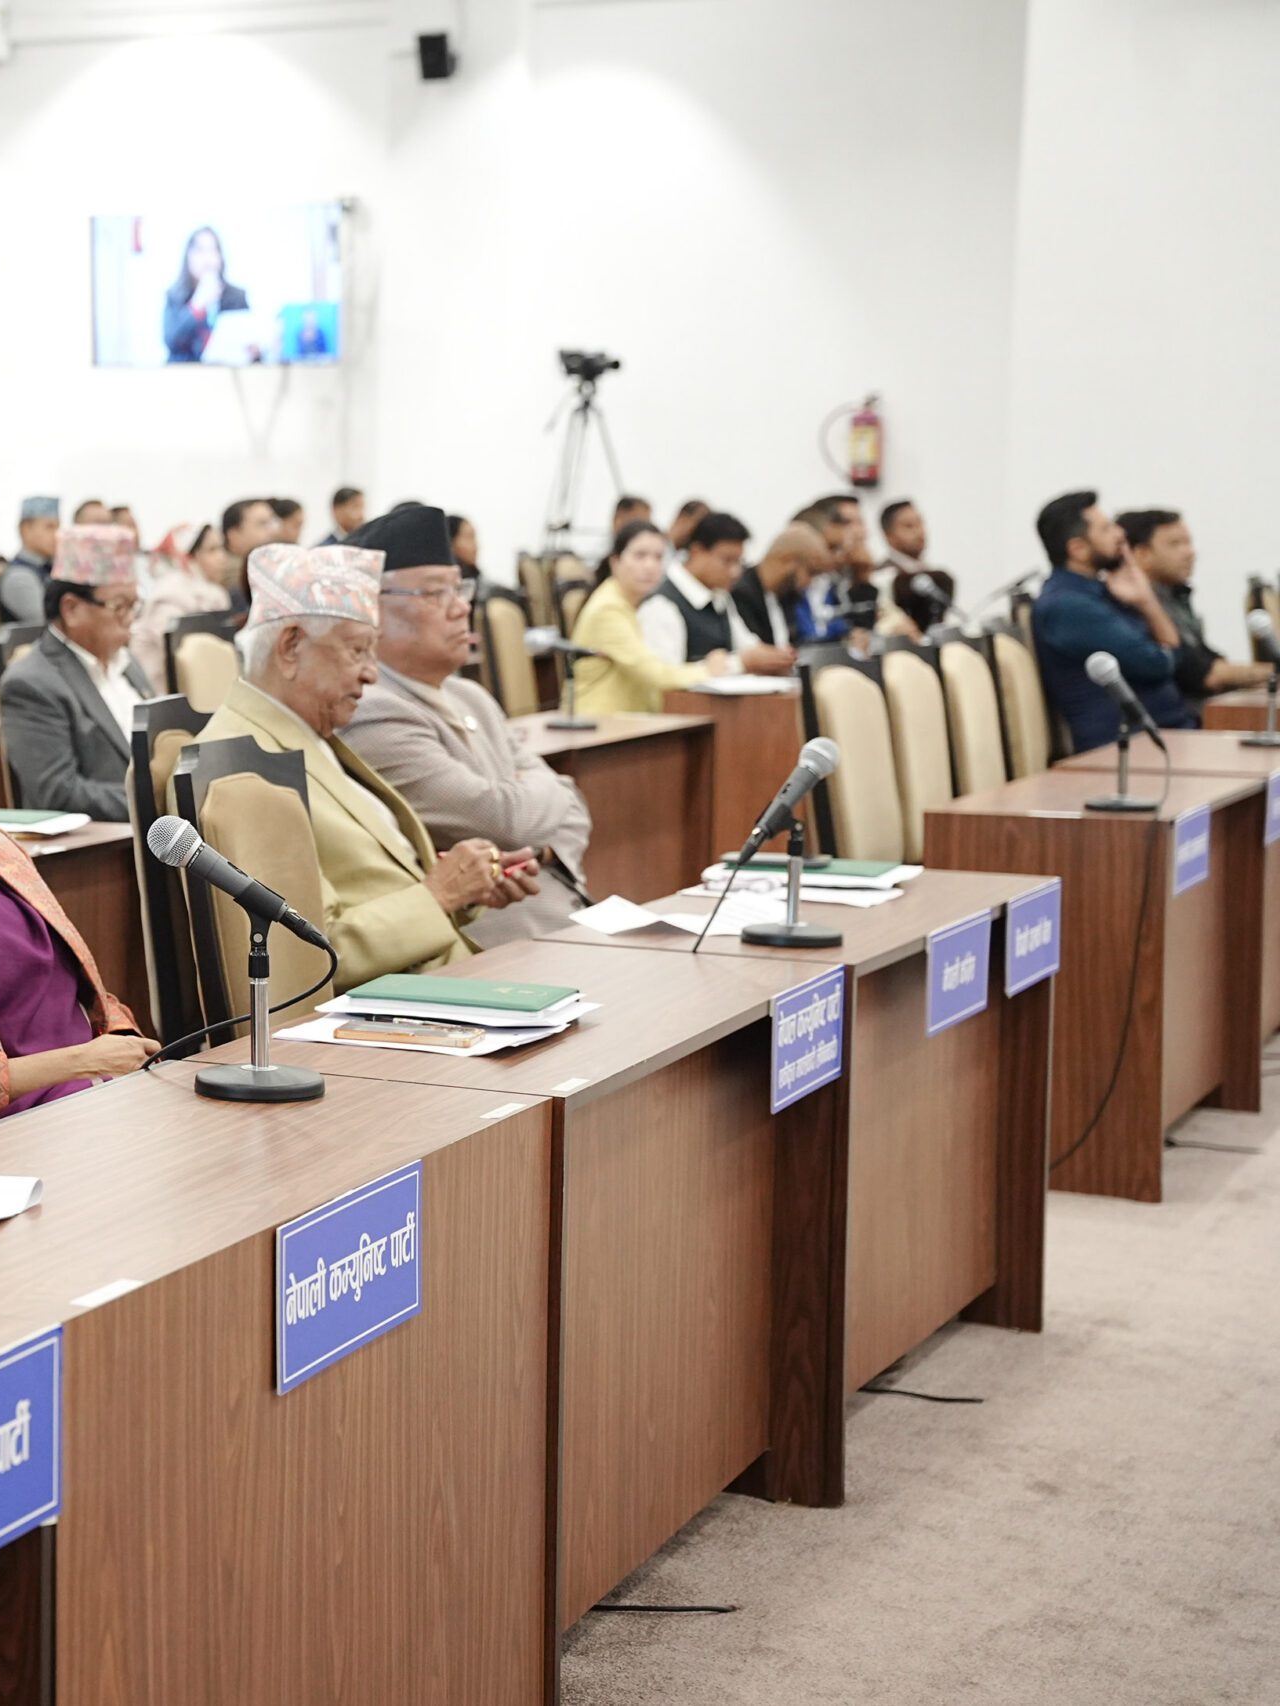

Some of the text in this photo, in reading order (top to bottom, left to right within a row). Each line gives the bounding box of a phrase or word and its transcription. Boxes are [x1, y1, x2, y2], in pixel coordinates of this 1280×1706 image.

[286, 1211, 416, 1326] नेपाली कम्युनिष्ट पार्टी
